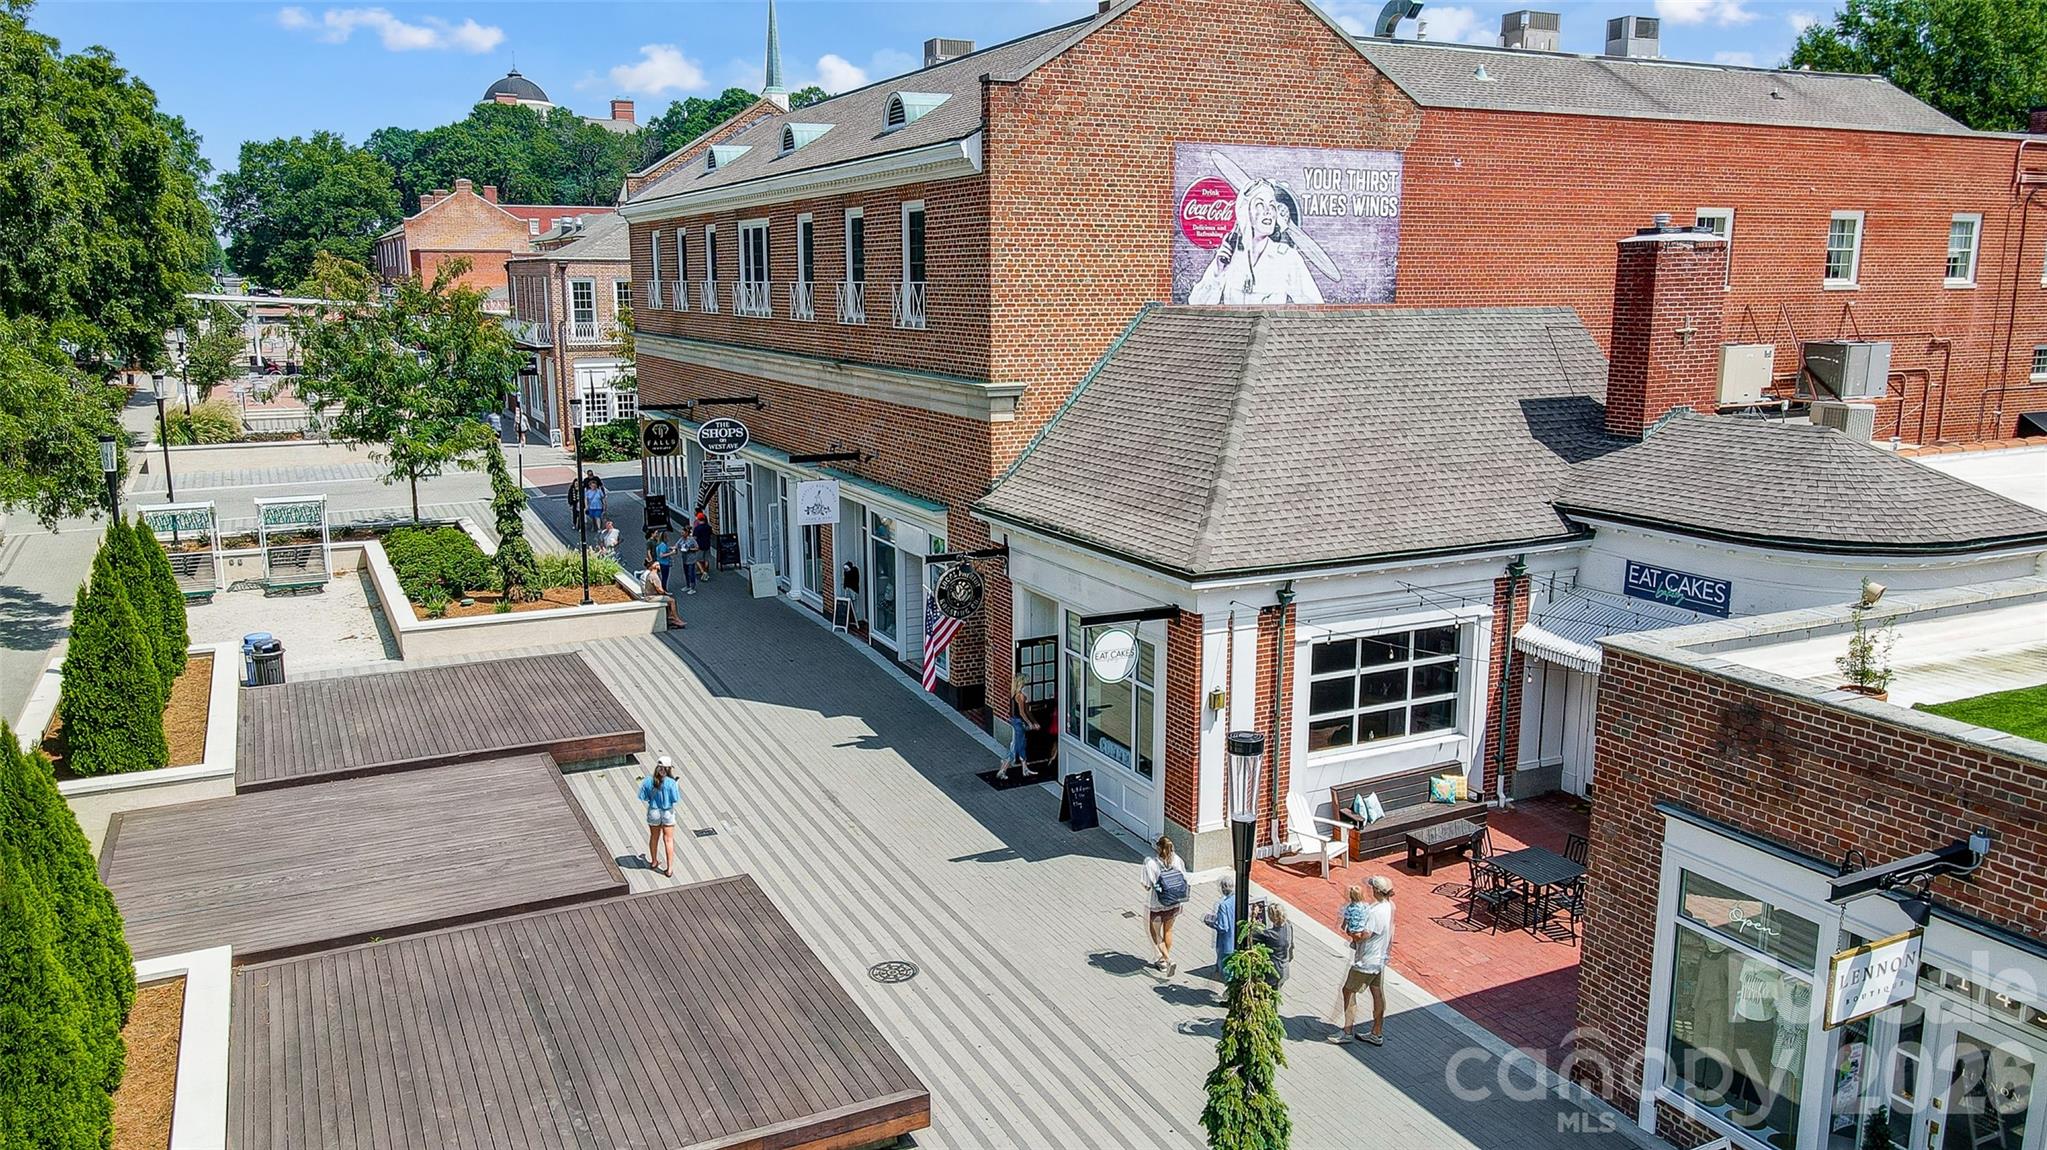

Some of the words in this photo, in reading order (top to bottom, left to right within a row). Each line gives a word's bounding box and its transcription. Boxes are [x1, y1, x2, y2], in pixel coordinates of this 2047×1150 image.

[1303, 167, 1342, 190] YOUR
[1346, 169, 1399, 192] THIRST
[1301, 193, 1347, 216] TAKES
[1352, 195, 1398, 217] WINGS
[701, 427, 744, 439] SHOPS
[1628, 564, 1661, 588] EAT
[1665, 573, 1726, 603] CAKES
[1095, 651, 1108, 660] EAT
[1110, 648, 1134, 659] CAKES
[1729, 907, 1779, 935] Open
[1839, 950, 1917, 989] LENNON
[1846, 980, 1904, 1005] BOUTIQUE
